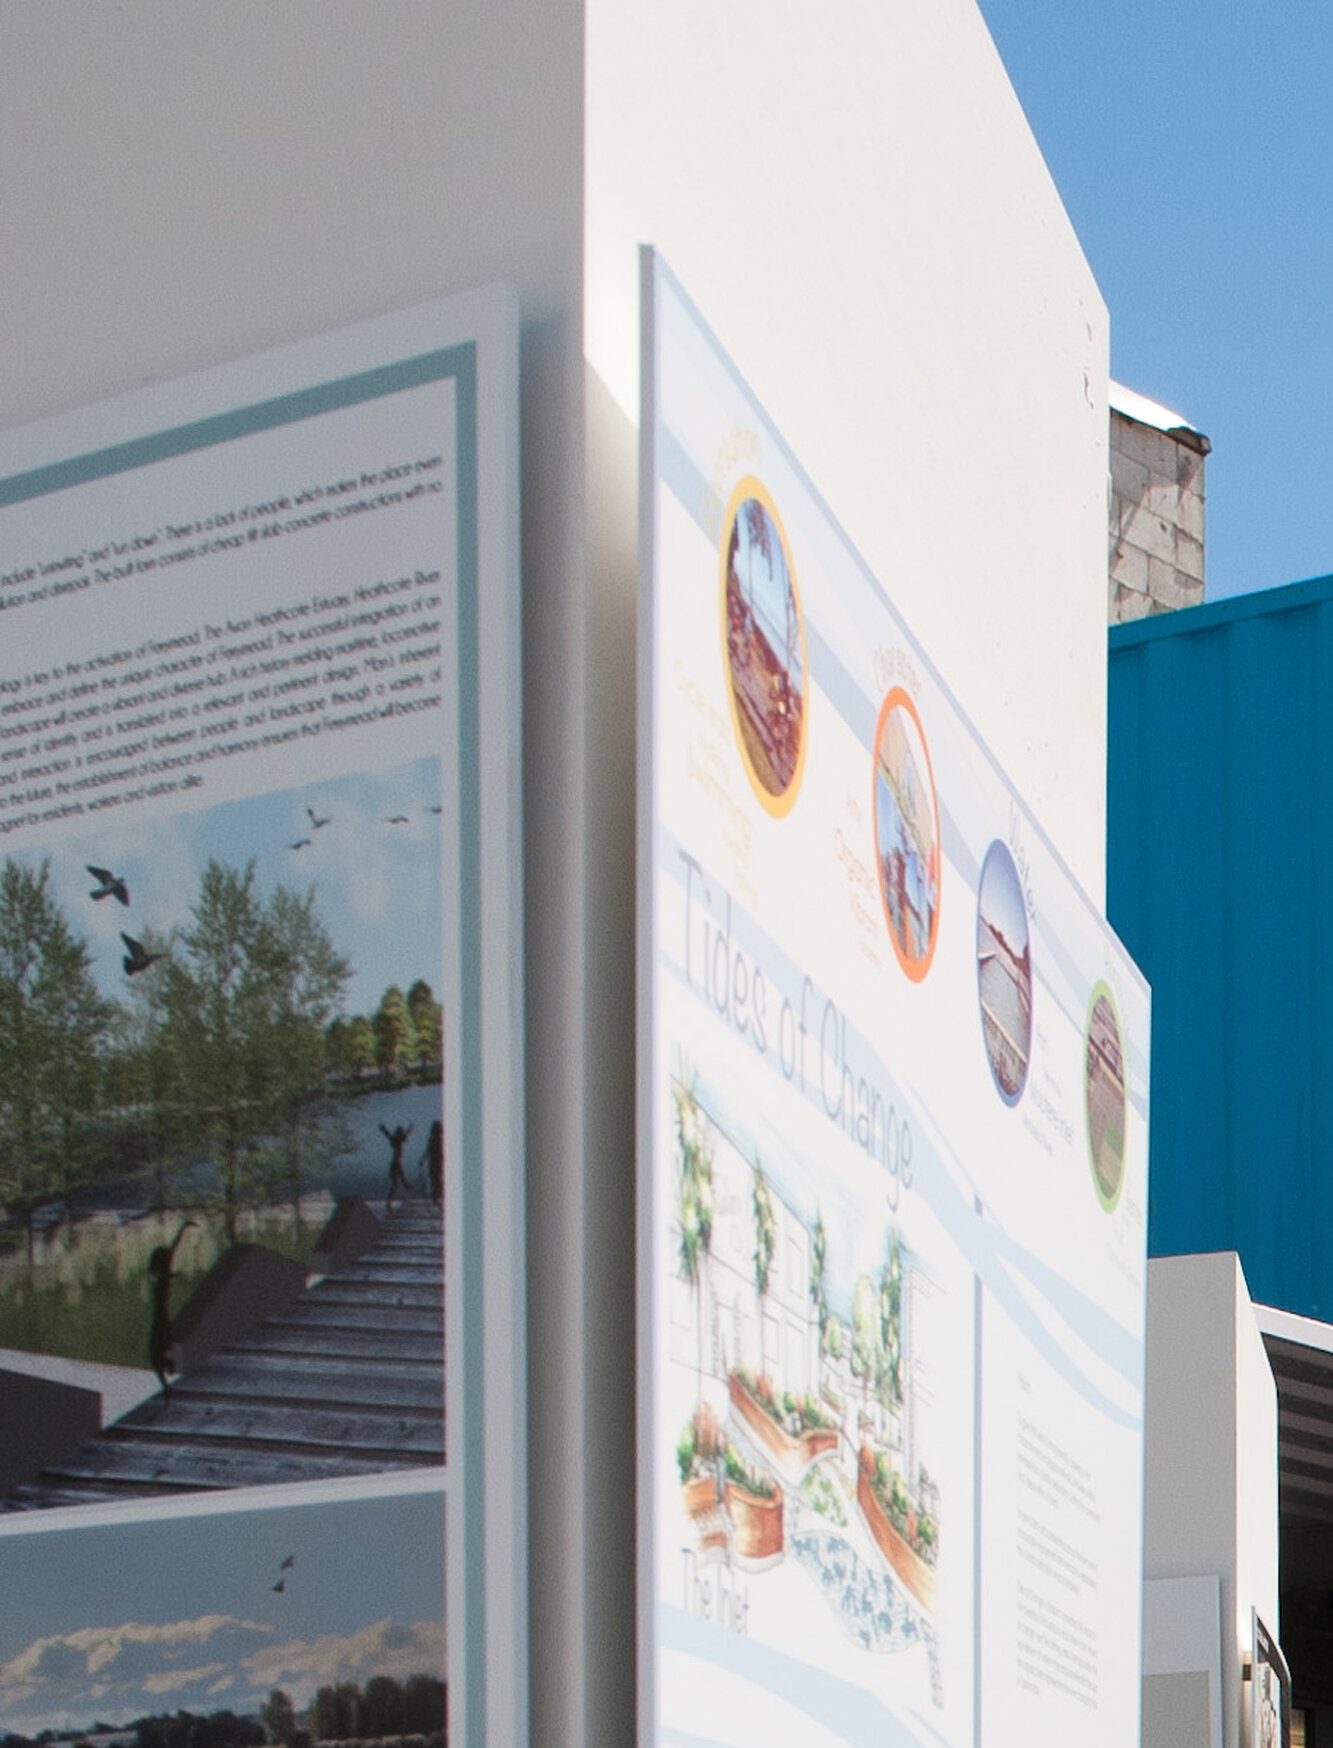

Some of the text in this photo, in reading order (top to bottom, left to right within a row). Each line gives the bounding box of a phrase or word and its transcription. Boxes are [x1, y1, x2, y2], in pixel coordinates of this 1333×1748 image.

[678, 850, 767, 1055] Tides
[780, 974, 812, 1092] of
[821, 999, 912, 1213] Change
